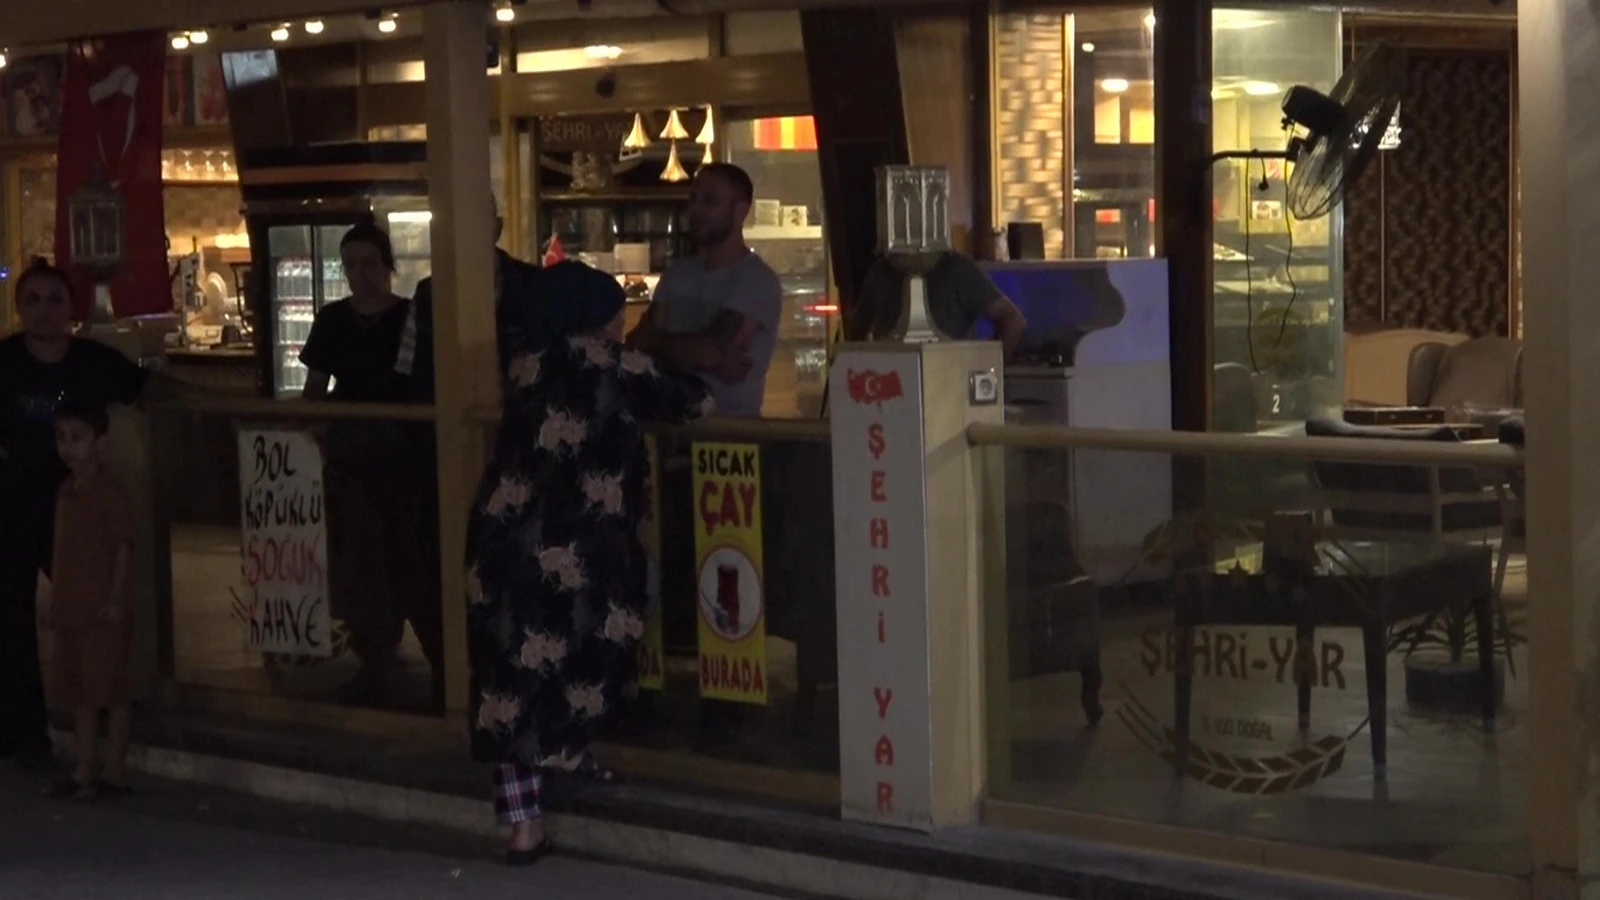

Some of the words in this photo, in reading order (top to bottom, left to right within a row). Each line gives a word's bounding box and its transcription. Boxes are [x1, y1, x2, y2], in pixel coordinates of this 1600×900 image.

[253, 435, 296, 484] BOL
[698, 449, 756, 476] SICAK
[699, 480, 757, 535] ÇAY
[249, 588, 322, 648] KAHVE
[701, 655, 765, 692] BURADA
[874, 687, 895, 814] YAR
